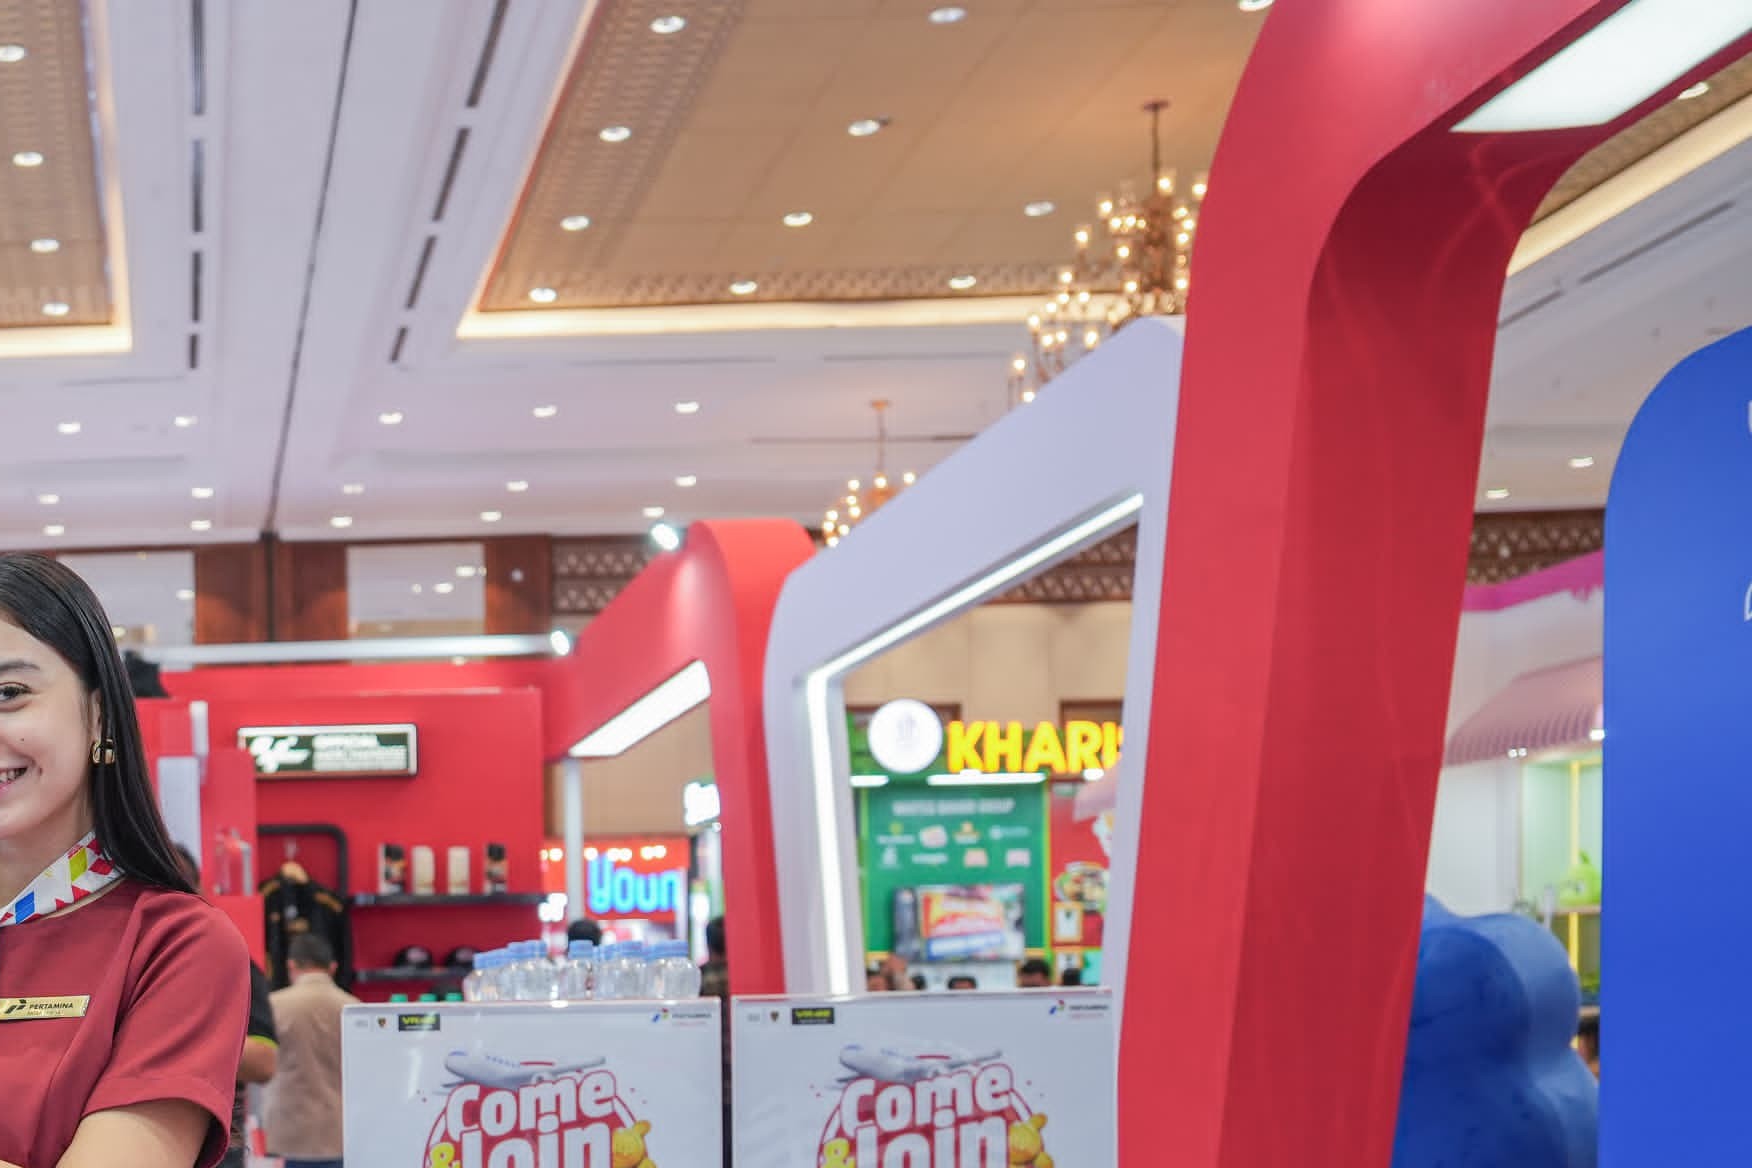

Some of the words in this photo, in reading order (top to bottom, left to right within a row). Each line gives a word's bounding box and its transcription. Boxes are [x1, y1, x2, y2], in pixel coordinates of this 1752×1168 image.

[29, 1002, 74, 1010] PERTAMINA
[446, 1071, 616, 1142] Come
[840, 1064, 1013, 1138] Come
